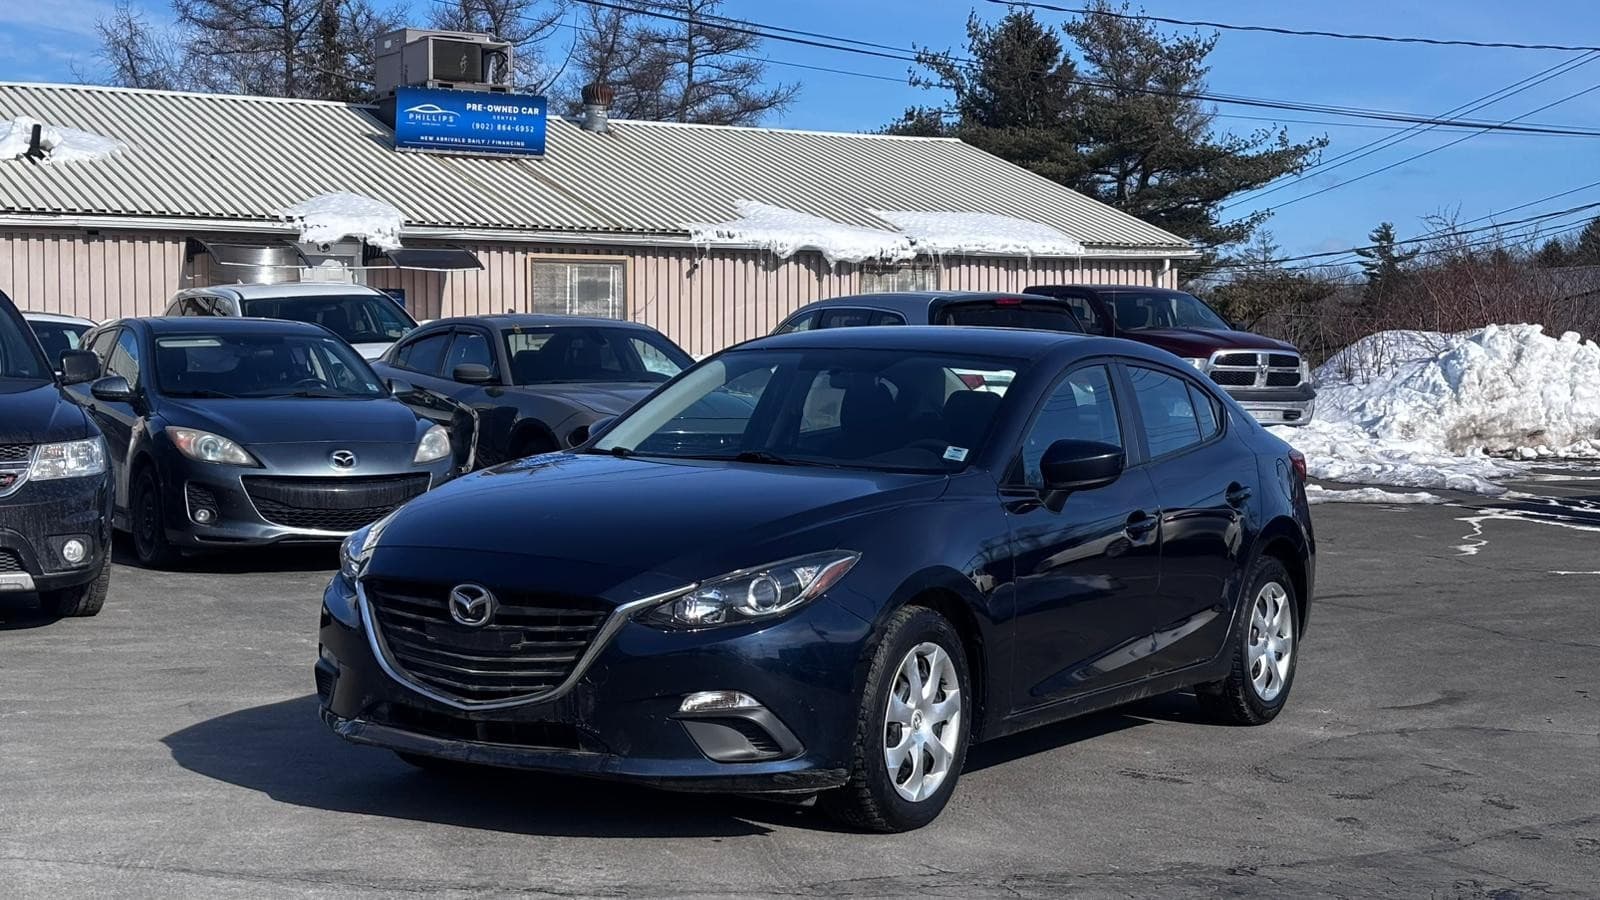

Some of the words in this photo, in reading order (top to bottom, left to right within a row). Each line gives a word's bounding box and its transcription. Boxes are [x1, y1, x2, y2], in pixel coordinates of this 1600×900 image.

[466, 103, 519, 114] PRE-OWNED
[521, 106, 539, 116] CAR
[408, 112, 455, 123] PHILLIPS
